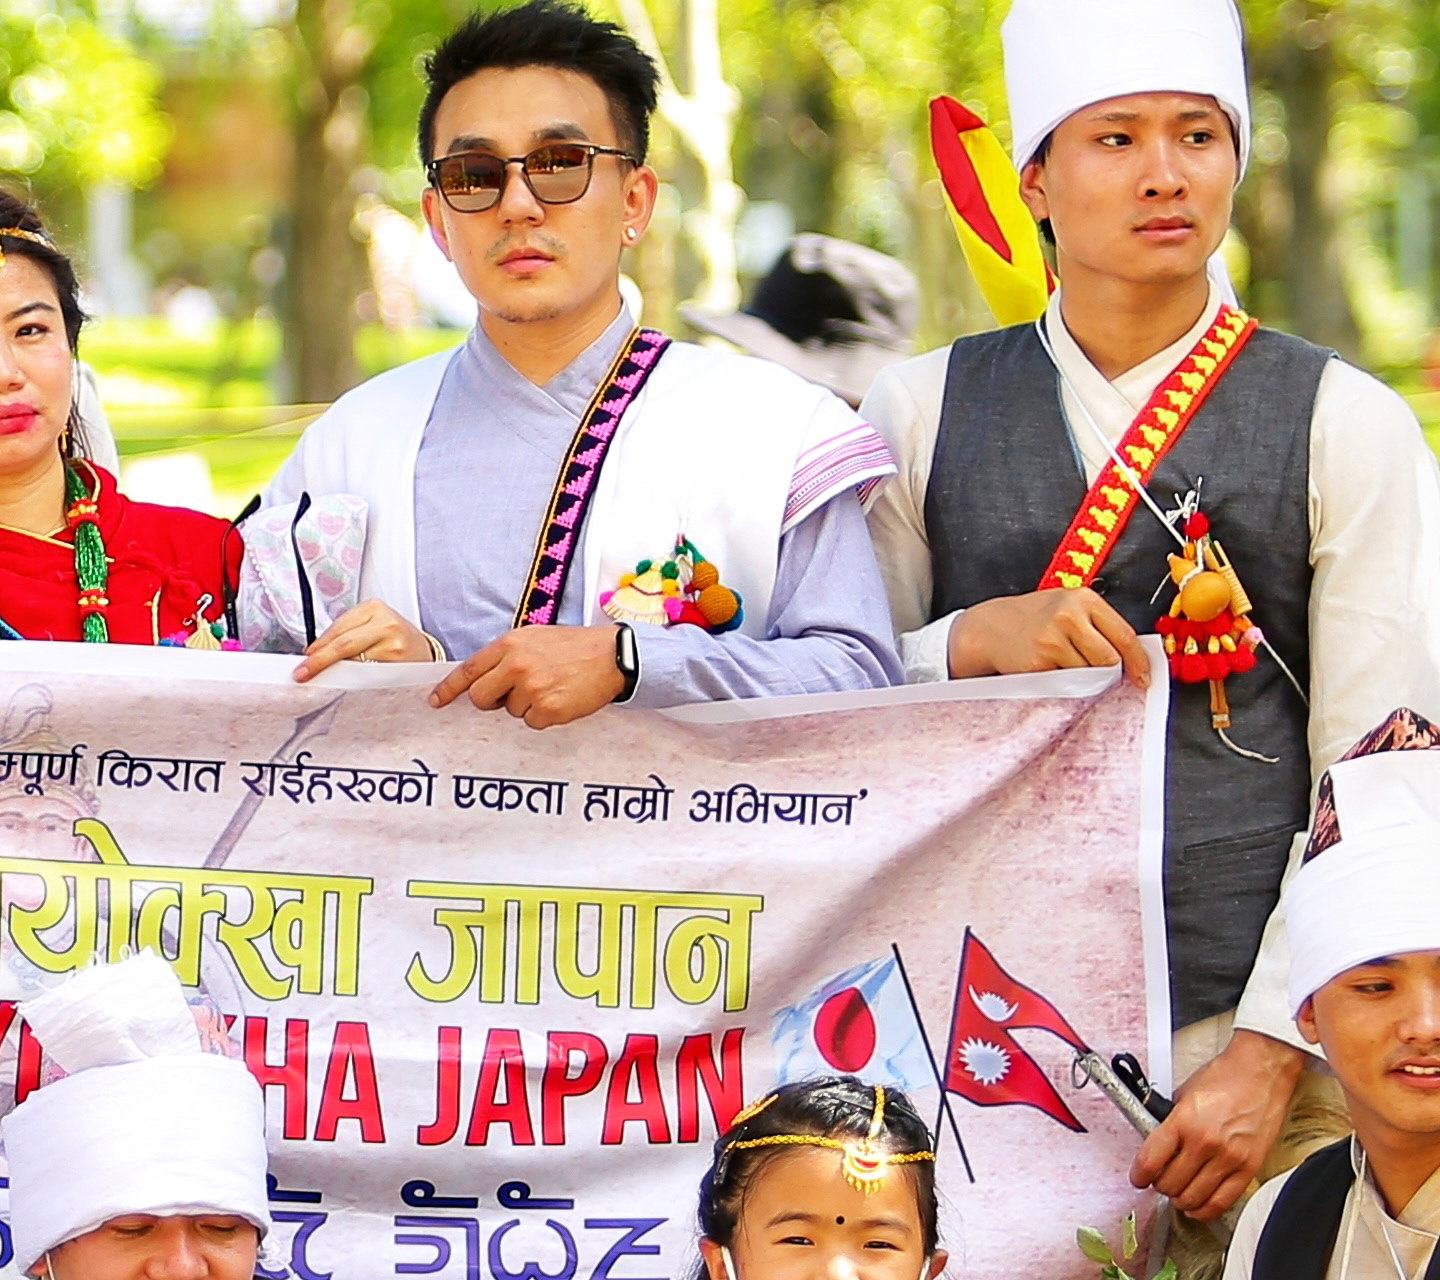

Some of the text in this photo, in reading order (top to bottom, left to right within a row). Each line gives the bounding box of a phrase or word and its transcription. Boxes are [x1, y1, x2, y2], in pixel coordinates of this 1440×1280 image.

[96, 750, 226, 794] किरात
[452, 774, 569, 816] एकता
[583, 774, 675, 823] हाम्रो
[406, 878, 764, 1013] जापान
[417, 1024, 746, 1148] JAPAN
